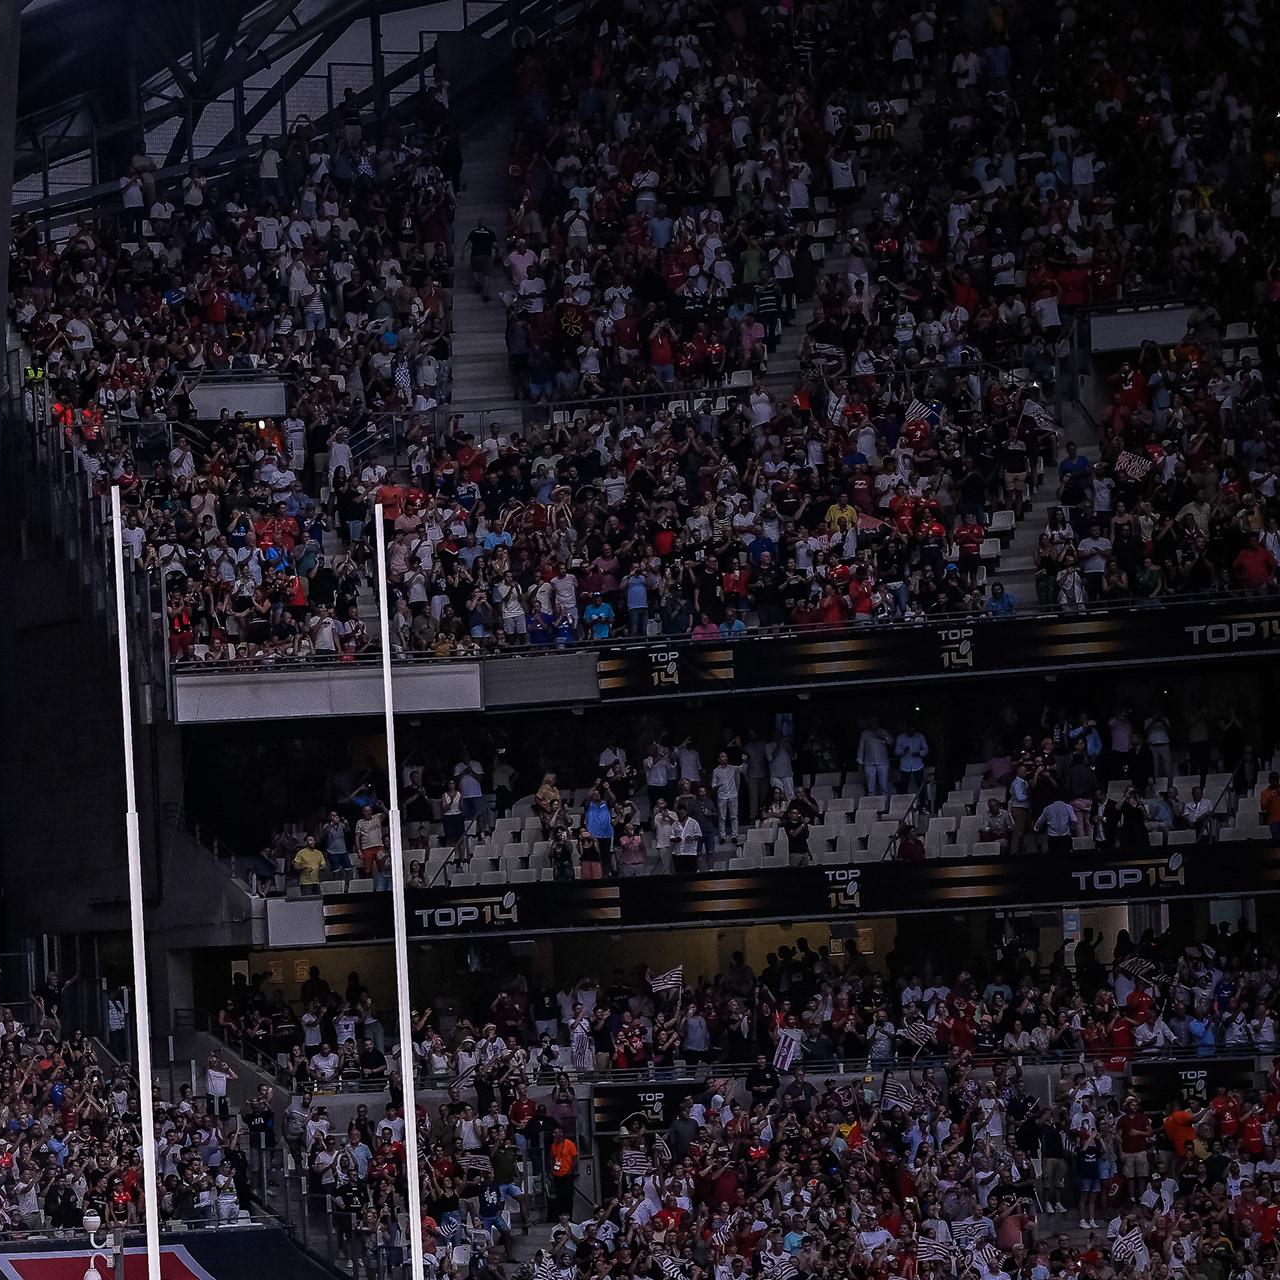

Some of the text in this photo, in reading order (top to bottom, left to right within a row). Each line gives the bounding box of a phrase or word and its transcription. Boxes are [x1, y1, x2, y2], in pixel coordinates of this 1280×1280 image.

[938, 628, 973, 641] TOP
[648, 651, 679, 663] TOP
[940, 650, 973, 667] 14
[651, 670, 679, 686] 14
[824, 869, 861, 881] TOP
[827, 891, 860, 908] 14
[1179, 1070, 1207, 1079] TOP
[637, 1092, 665, 1101] TOP
